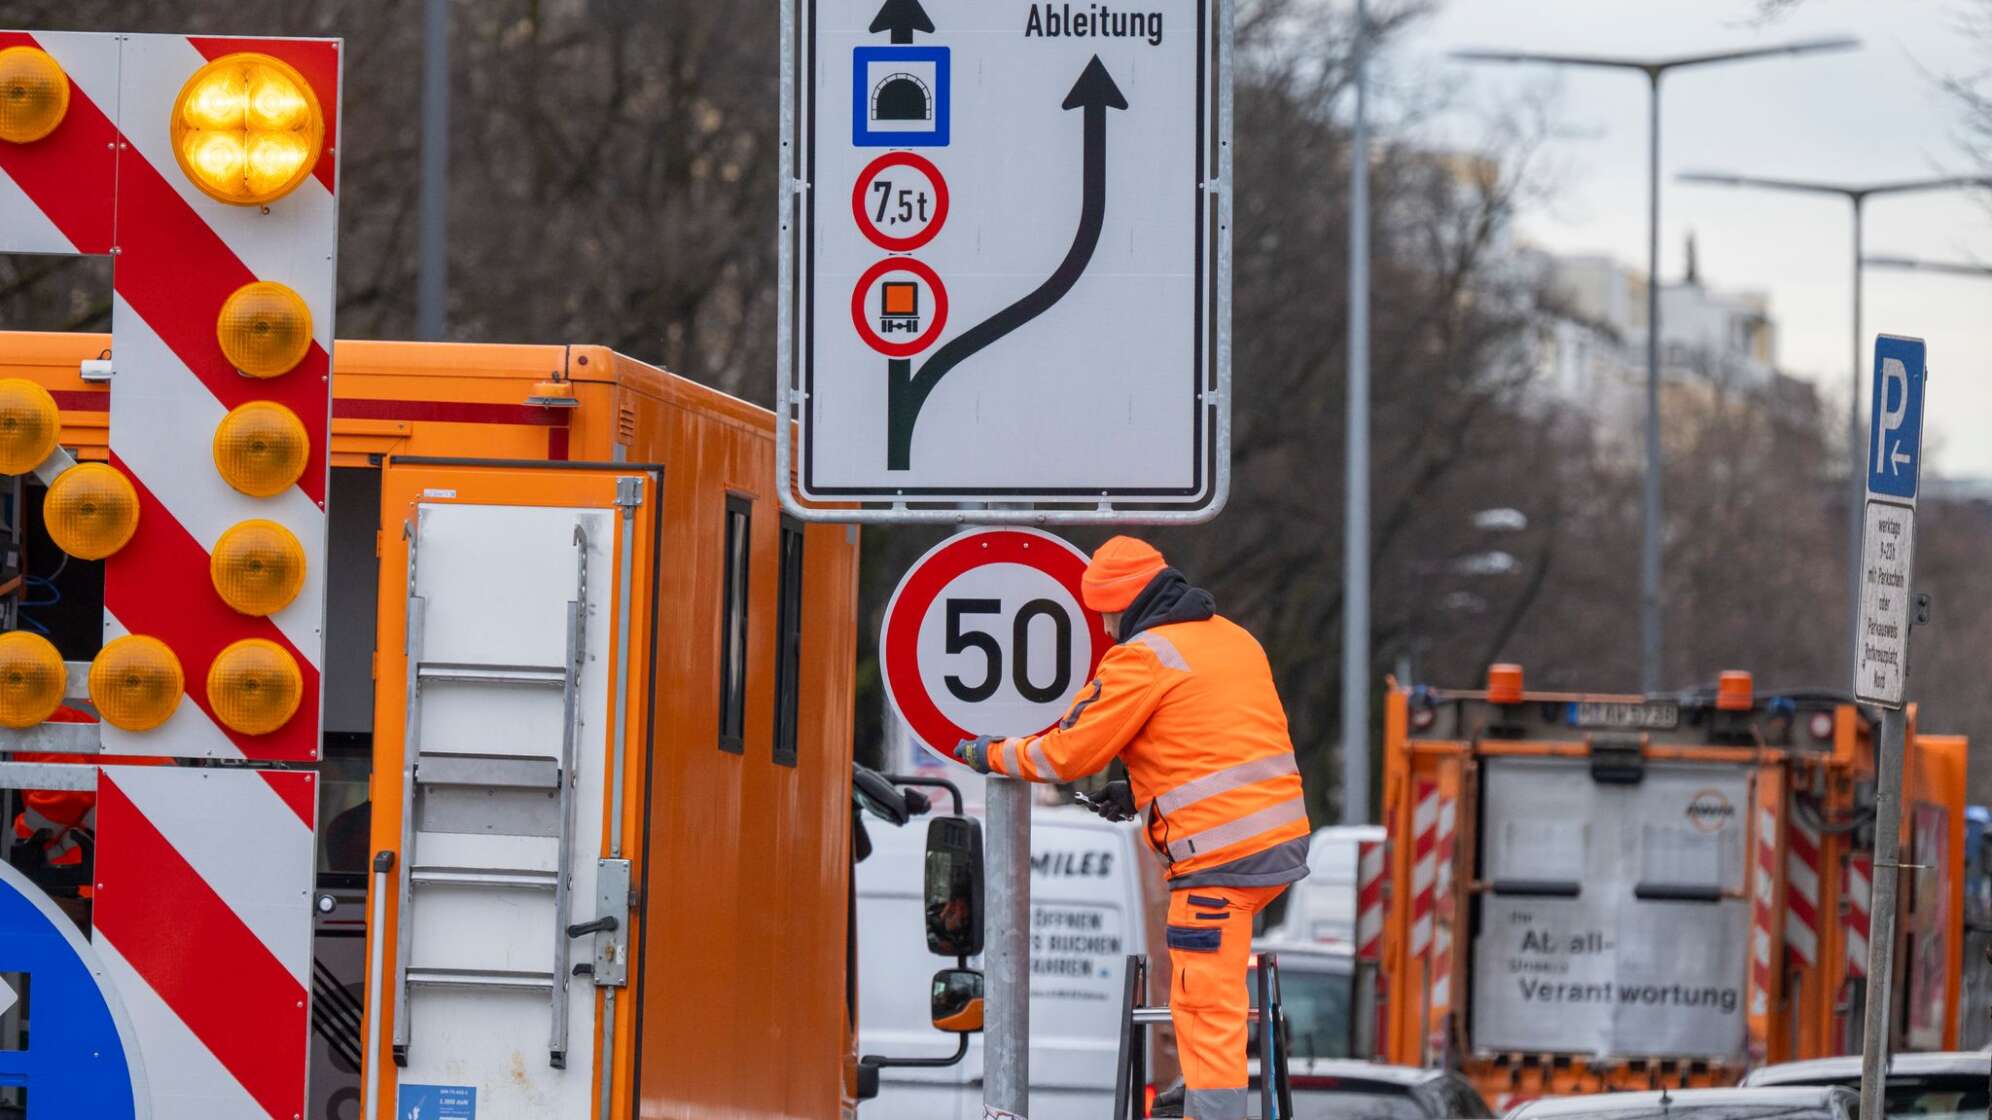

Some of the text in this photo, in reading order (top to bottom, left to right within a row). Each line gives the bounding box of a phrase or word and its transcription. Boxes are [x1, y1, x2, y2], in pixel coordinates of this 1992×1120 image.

[1025, 4, 1162, 46] Ableitung
[1876, 357, 1908, 474] P
[943, 598, 1072, 704] 50
[1030, 851, 1114, 877] MILES
[1519, 979, 1737, 1014] Verantwortung
